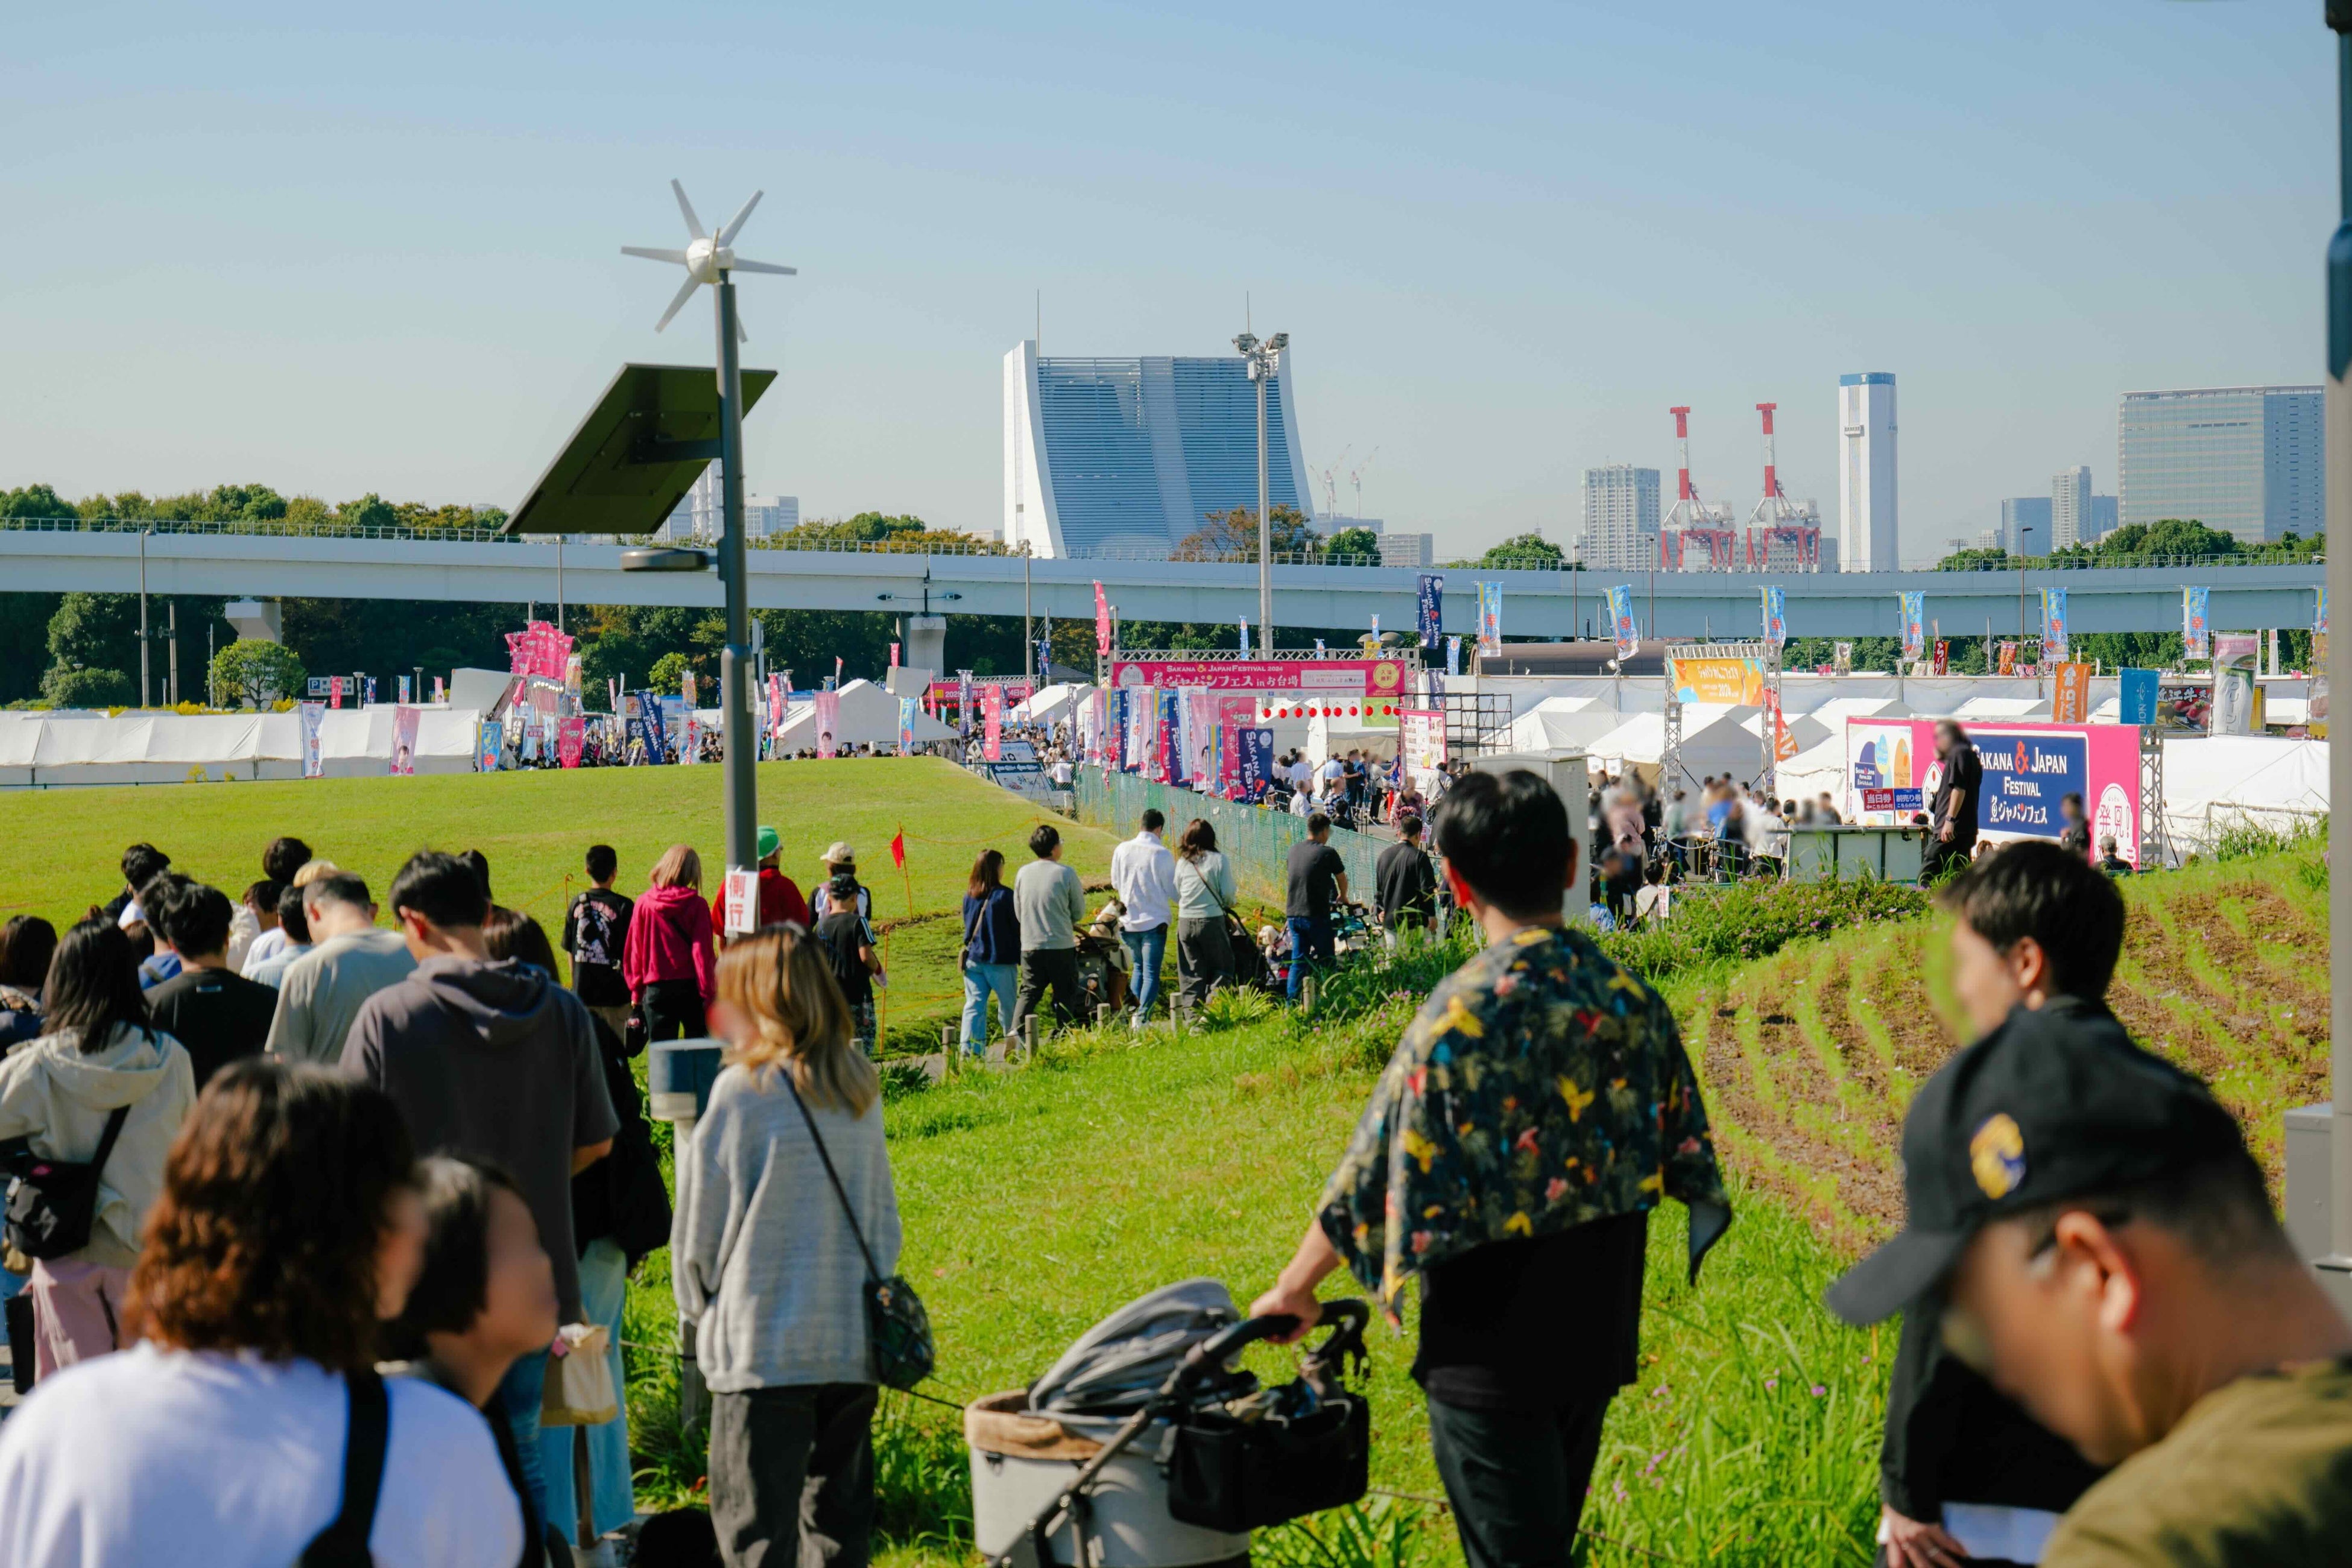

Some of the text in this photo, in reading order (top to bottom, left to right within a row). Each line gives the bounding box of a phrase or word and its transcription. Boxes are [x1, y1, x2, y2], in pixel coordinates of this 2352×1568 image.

[1425, 577, 1434, 609] SAKANA
[1421, 598, 1432, 634] FESTIVAL
[1267, 675, 1298, 687] お台場
[643, 694, 658, 725] SAKANA
[643, 716, 659, 751] FESTIVAL
[1246, 731, 1260, 777] SAKANA
[2031, 747, 2067, 774] JAPAN
[1867, 793, 1891, 803] 当日券
[2003, 776, 2041, 797] FESTIVAL
[1990, 794, 2048, 824] 魚ジャパンフェス
